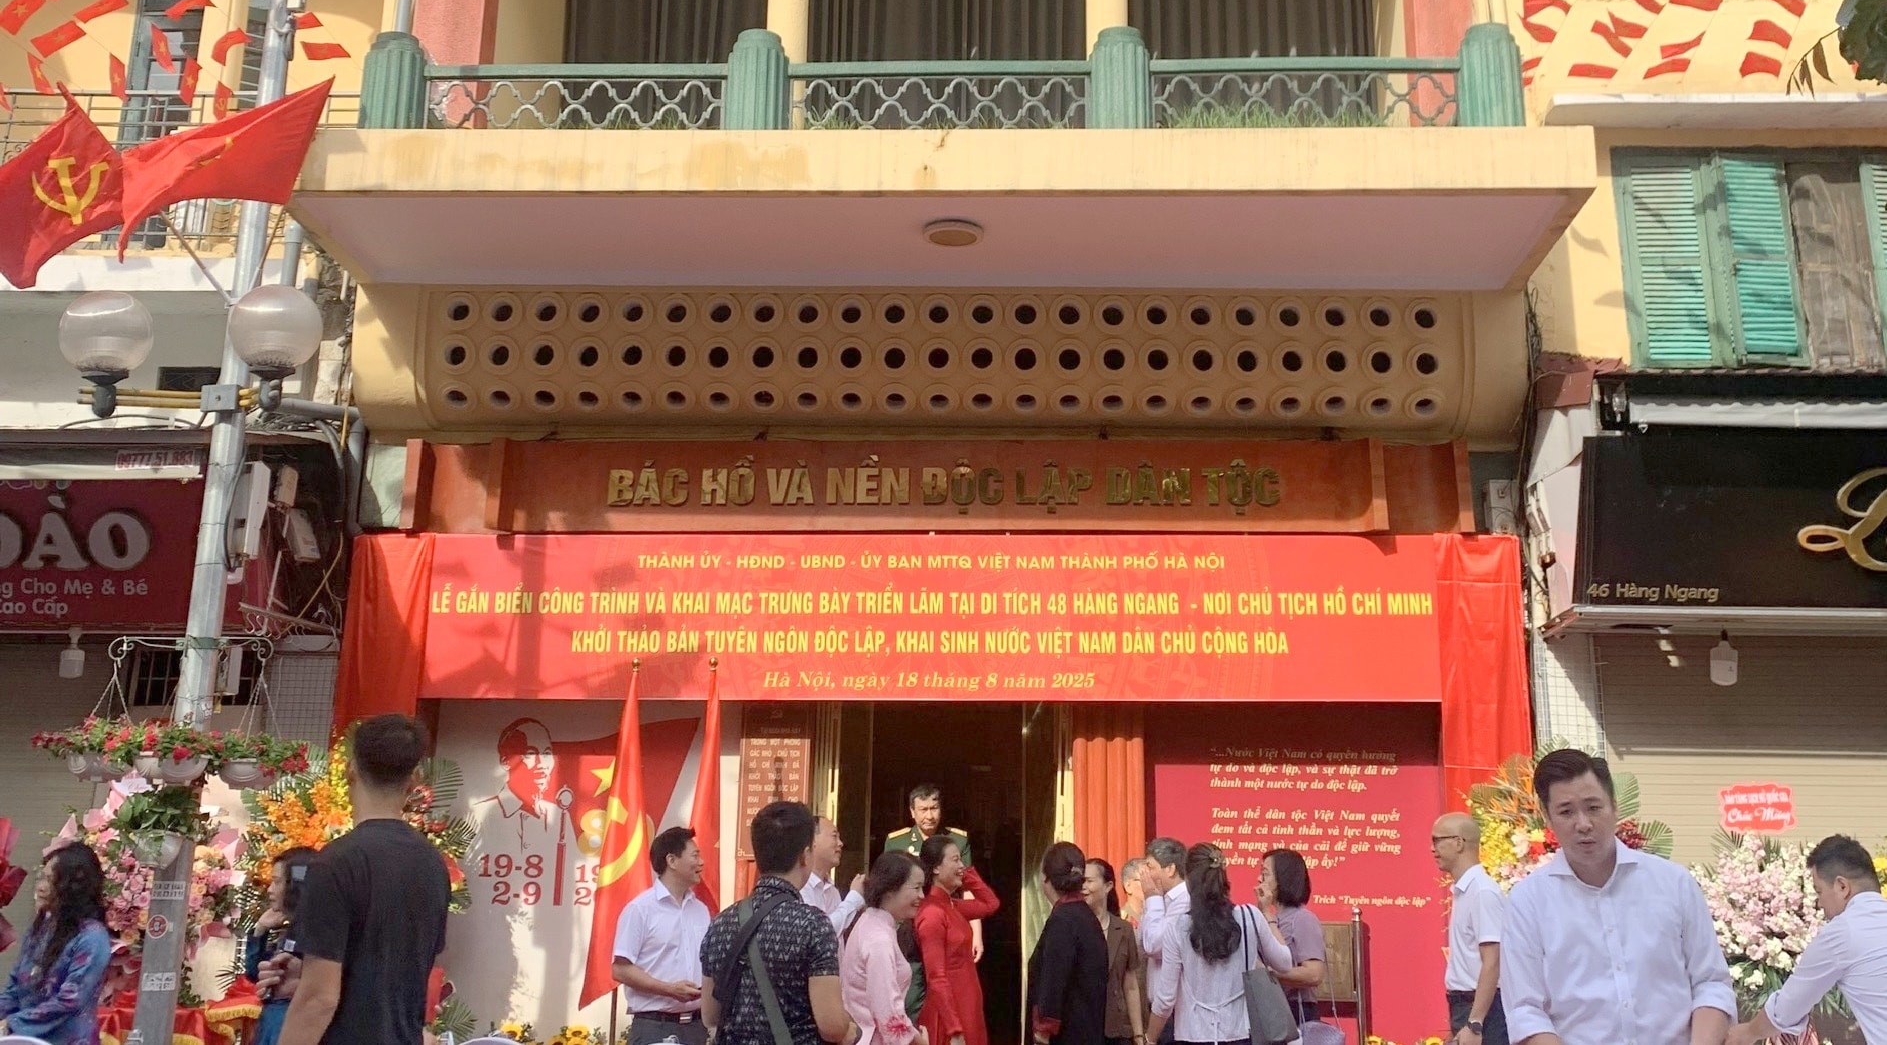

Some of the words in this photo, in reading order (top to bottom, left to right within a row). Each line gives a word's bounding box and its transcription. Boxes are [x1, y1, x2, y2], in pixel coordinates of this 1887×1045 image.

[607, 459, 689, 506] BÁC
[700, 454, 755, 506] HỒ
[766, 459, 814, 505] VÀ
[826, 454, 910, 505] NỀN
[921, 458, 1003, 514] ĐỘC
[1016, 458, 1092, 514] LẬP
[1106, 460, 1191, 506] DÂN
[1202, 458, 1280, 514] TỘC
[638, 552, 694, 569] THÀNH
[700, 550, 721, 569] ỦY
[736, 555, 785, 569] HĐND
[801, 555, 846, 569] UBND
[861, 551, 882, 569] ỦY
[888, 555, 922, 569] BAN
[928, 555, 972, 570] MTTQ
[978, 552, 1010, 573] VIỆT
[1016, 556, 1054, 569] NAM
[1061, 552, 1117, 569] THÀNH
[1123, 551, 1159, 569] PHỐ
[1165, 552, 1188, 569] HÀ
[1194, 554, 1225, 573] NỘI
[21, 577, 57, 594] Cho
[64, 578, 94, 599] Mẹ
[101, 579, 116, 595] &
[123, 579, 149, 595] Bé
[1587, 583, 1609, 598] 46
[1616, 583, 1660, 601] Hàng
[1664, 584, 1719, 602] Ngang
[0, 598, 27, 615] ao
[32, 596, 69, 619] Cấp
[432, 583, 451, 613] LỄ
[456, 584, 489, 614] GẮN
[495, 582, 532, 614] BIỂN
[538, 587, 584, 614] CÔNG
[590, 588, 640, 614] TRÌNH
[645, 588, 666, 614] VÀ
[672, 591, 710, 614] KHAI
[715, 592, 752, 619] MẠC
[759, 589, 813, 614] TRƯNG
[819, 587, 850, 614] BÀY
[856, 582, 903, 614] TRIỂN
[910, 587, 943, 614] LÃM
[949, 592, 975, 619] TẠI
[981, 592, 997, 614] DI
[1003, 588, 1041, 614] TÍCH
[1047, 592, 1067, 614] 48
[1073, 587, 1118, 614] HÀNG
[1124, 593, 1180, 615] NGANG
[1204, 590, 1232, 615] NƠI
[1238, 586, 1272, 615] CHỦ
[1278, 593, 1318, 620] TỊCH
[1323, 585, 1346, 615] HỒ
[1352, 588, 1382, 615] CHÍ
[1388, 593, 1433, 615] MINH
[571, 624, 611, 653] KHỞI
[617, 624, 660, 653] THẢO
[666, 624, 699, 653] BẢN
[705, 626, 757, 653] TUYÊN
[763, 626, 808, 653] NGÔN
[814, 626, 848, 658] ĐỘC
[855, 626, 890, 658] LẬP,
[896, 630, 934, 654] KHAI
[940, 630, 979, 654] SINH
[985, 626, 1031, 654] NƯỚC
[1037, 627, 1073, 658] VIỆT
[1079, 631, 1116, 654] NAM
[1122, 626, 1155, 654] DÂN
[1161, 624, 1196, 654] CHỦ
[1202, 626, 1249, 659] CỘNG
[1254, 627, 1289, 654] HÒA
[763, 672, 790, 688] Hà
[797, 672, 835, 692] Nội,
[842, 673, 888, 689] ngày
[896, 672, 918, 687] 18
[923, 672, 980, 691] tháng
[985, 673, 998, 687] 8
[1003, 673, 1046, 688] năm
[1051, 673, 1095, 688] 2025
[1258, 748, 1278, 760] Việt
[1282, 748, 1306, 758] Nam
[1310, 749, 1323, 759] có
[1210, 763, 1222, 775] tự
[1225, 763, 1239, 773] do
[1243, 763, 1255, 773] và
[1259, 763, 1279, 775] độc
[1306, 764, 1319, 774] và
[1322, 765, 1336, 777] sự
[1339, 764, 1361, 777] thật
[1364, 765, 1378, 775] đã
[1210, 777, 1241, 788] thành
[1244, 778, 1264, 790] một
[1266, 778, 1294, 789] nước
[1296, 779, 1309, 791] tự
[1310, 779, 1324, 790] do
[1326, 779, 1346, 792] độc
[1347, 779, 1367, 793] lập.
[1211, 807, 1238, 819] Toàn
[1243, 805, 1261, 819] thể
[1265, 809, 1286, 820] dân
[1291, 809, 1308, 822] tộc
[1313, 809, 1335, 823] Việt
[1339, 810, 1366, 821] Nam
[1371, 808, 1401, 824] quyết
[1211, 823, 1235, 835] đem
[1238, 820, 1253, 835] tất
[1272, 824, 1295, 836] tinh
[1327, 825, 1340, 836] và
[1343, 825, 1362, 838] lực
[1238, 840, 1269, 853] mạng
[1272, 839, 1286, 850] và
[1374, 841, 1402, 856] vững
[478, 854, 544, 878] 19-8
[1246, 856, 1260, 868] tự
[491, 881, 542, 906] 2-9
[1371, 895, 1393, 907] ngôn
[1394, 896, 1411, 908] độc
